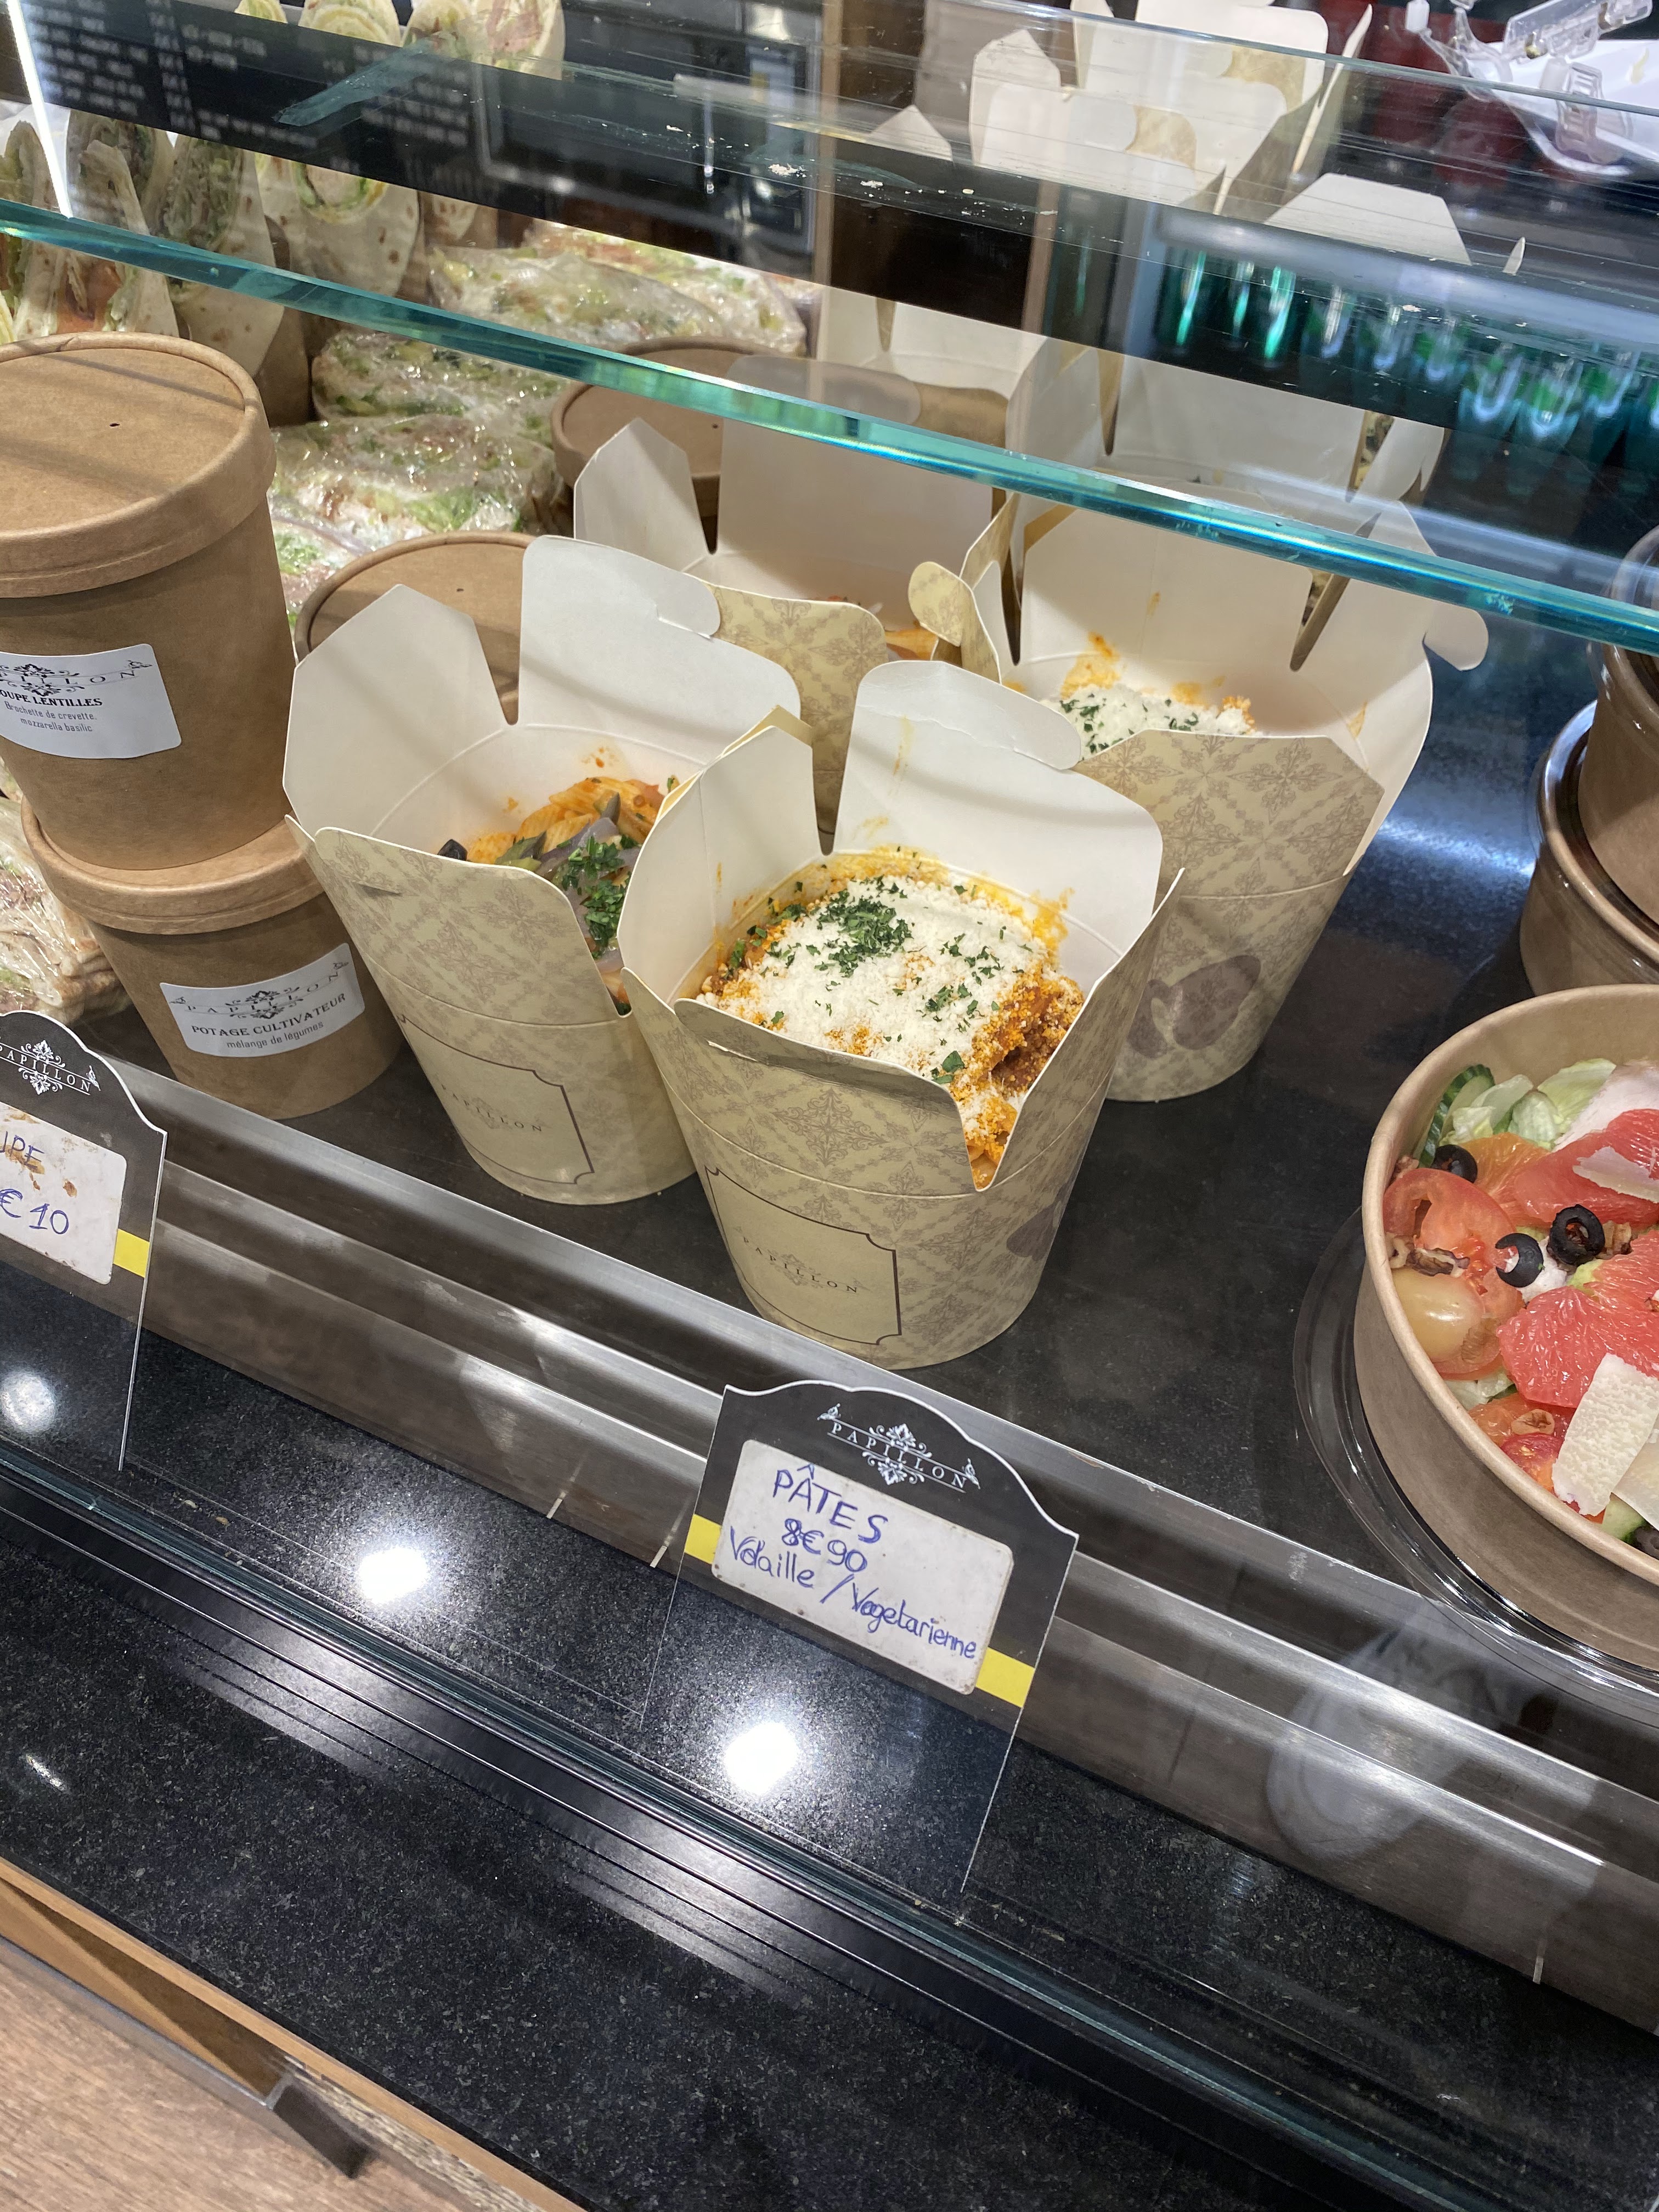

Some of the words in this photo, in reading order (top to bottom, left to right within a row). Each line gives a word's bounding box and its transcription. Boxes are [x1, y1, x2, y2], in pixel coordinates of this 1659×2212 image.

[0, 690, 31, 703] OUPE
[32, 696, 103, 707] LENTILLES
[4, 701, 43, 718] Brochette
[46, 710, 55, 719] de
[20, 718, 63, 731] mozzarella
[64, 723, 93, 732] basilic
[188, 972, 338, 1013] PAPILLON
[191, 1025, 250, 1036] POTAGE
[253, 993, 346, 1035] CULTIVATEUR
[270, 1035, 283, 1045] de
[743, 1236, 857, 1293] PAPILLON
[831, 1421, 967, 1489] PAPILLON
[771, 1463, 889, 1543] PÂTES
